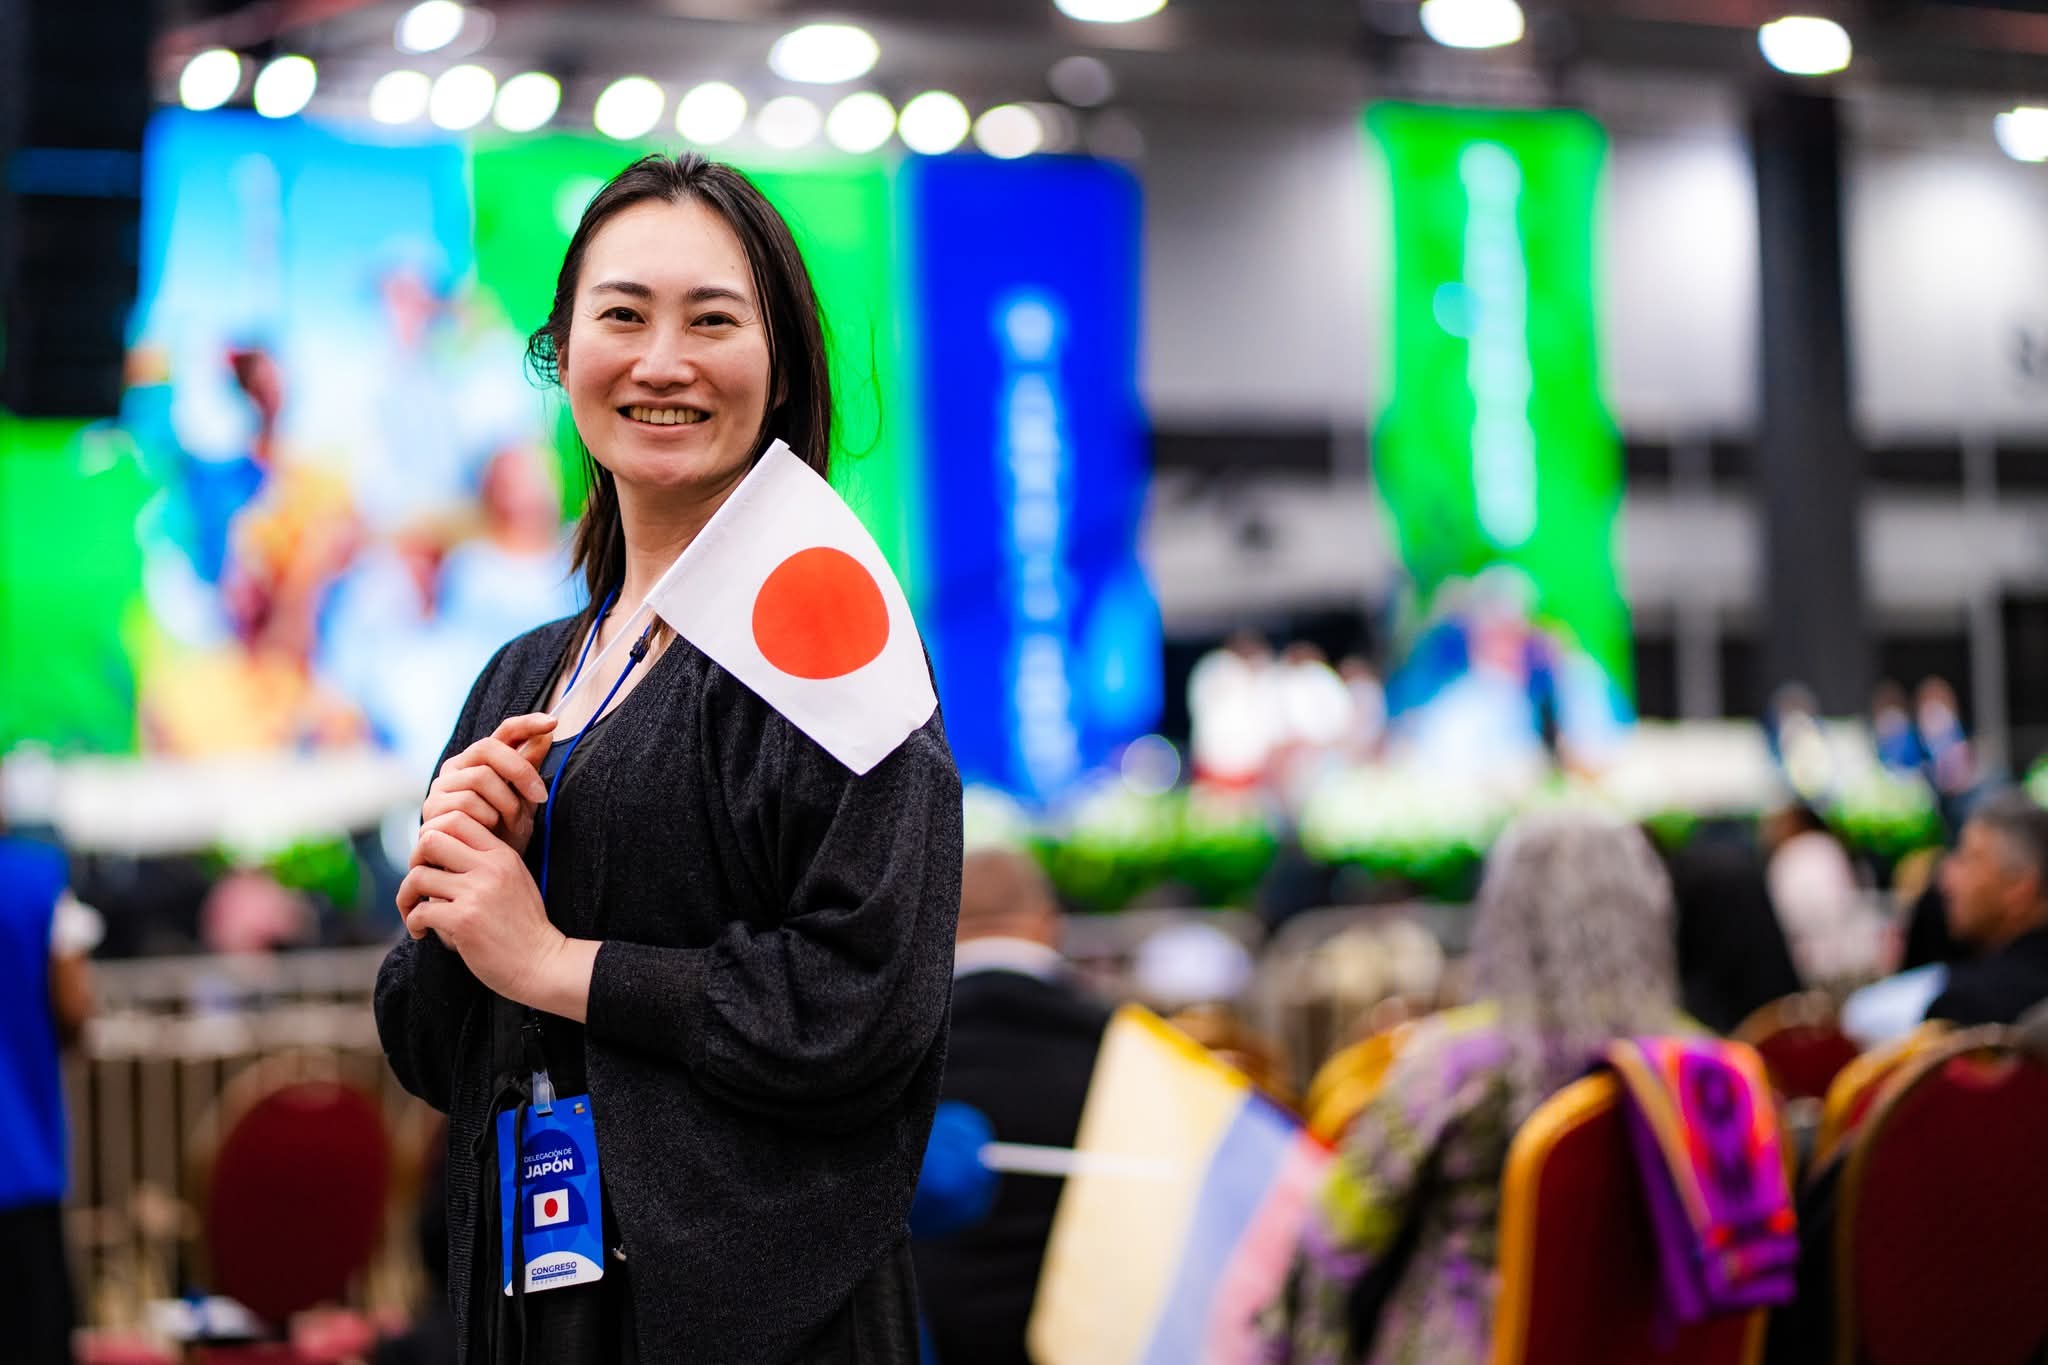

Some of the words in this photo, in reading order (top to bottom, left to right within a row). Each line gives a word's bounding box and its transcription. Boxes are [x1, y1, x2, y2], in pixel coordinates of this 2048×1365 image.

[524, 1148, 563, 1163] DELEGACIÓN
[563, 1147, 572, 1156] DE
[525, 1156, 573, 1179] JAPÓN
[531, 1261, 577, 1276] CONGRESO
